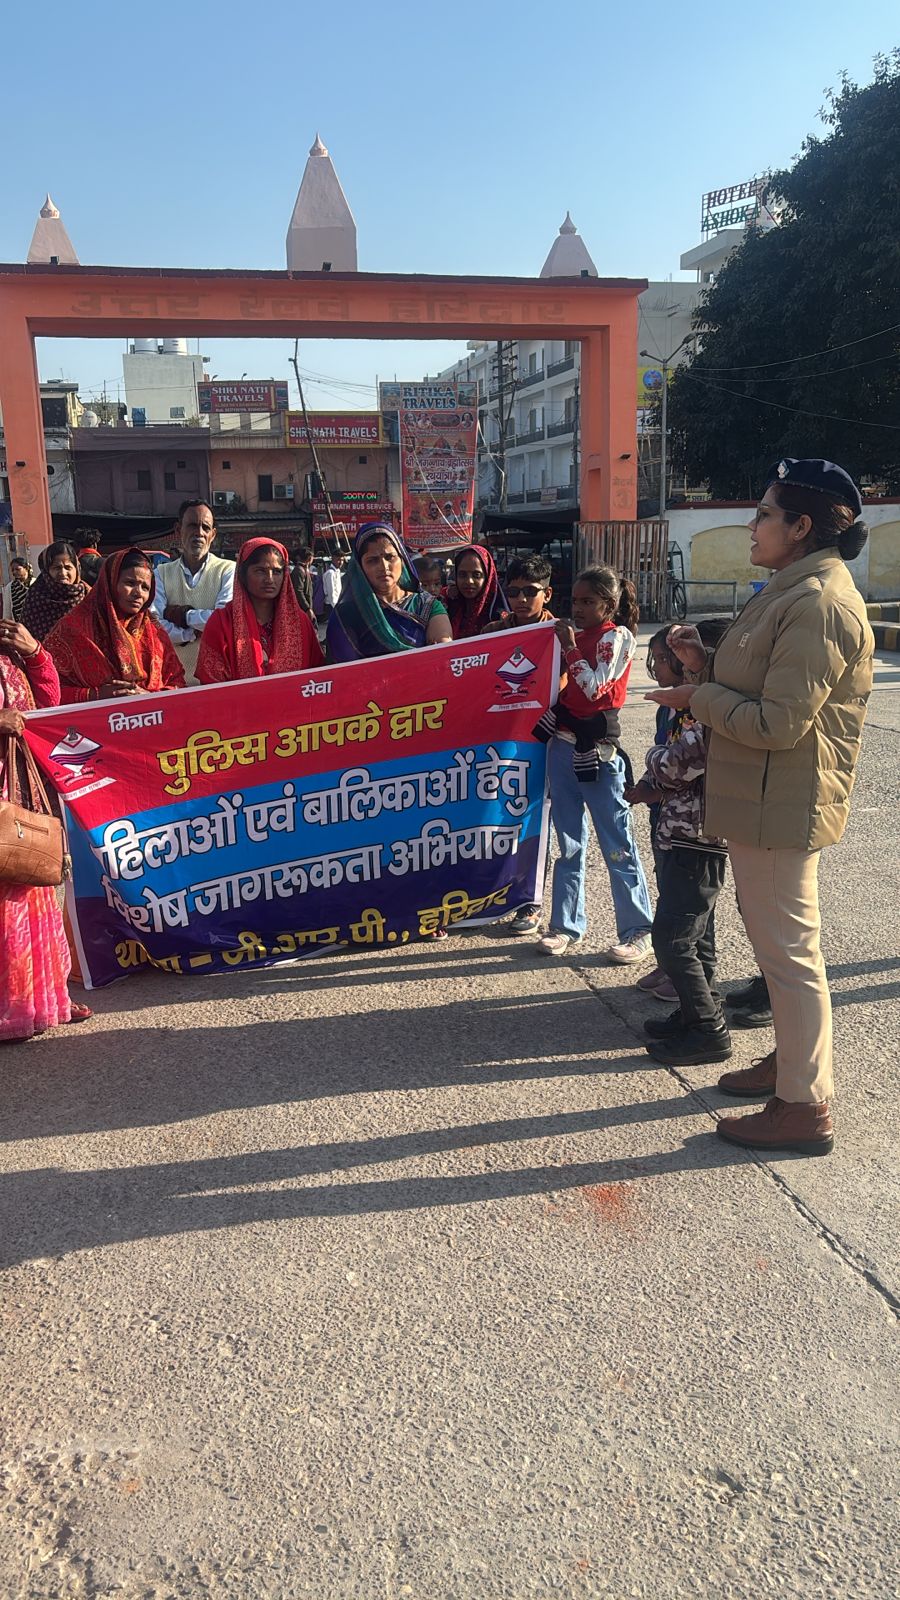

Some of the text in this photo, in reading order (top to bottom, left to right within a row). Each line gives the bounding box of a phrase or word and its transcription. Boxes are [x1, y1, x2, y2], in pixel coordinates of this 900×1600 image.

[707, 181, 757, 209] HOTEL
[702, 203, 760, 231] ASHOKA
[212, 386, 268, 394] SHRI NATH
[216, 394, 264, 402] TRAVELS
[402, 387, 454, 397] RITIKA
[402, 398, 456, 409] TRAVELS
[289, 427, 378, 438] SHR NATH TRAVELS
[314, 523, 334, 531] SHR
[107, 652, 490, 733] मित्रता सेवा सुरक्षा
[156, 699, 448, 796] पुलिस आपके द्वार
[243, 782, 297, 842] एवं
[302, 750, 475, 826] बालिकाओं
[475, 745, 531, 817] हेतु
[189, 843, 384, 915] जागरूकता
[387, 818, 522, 876] अभियान
